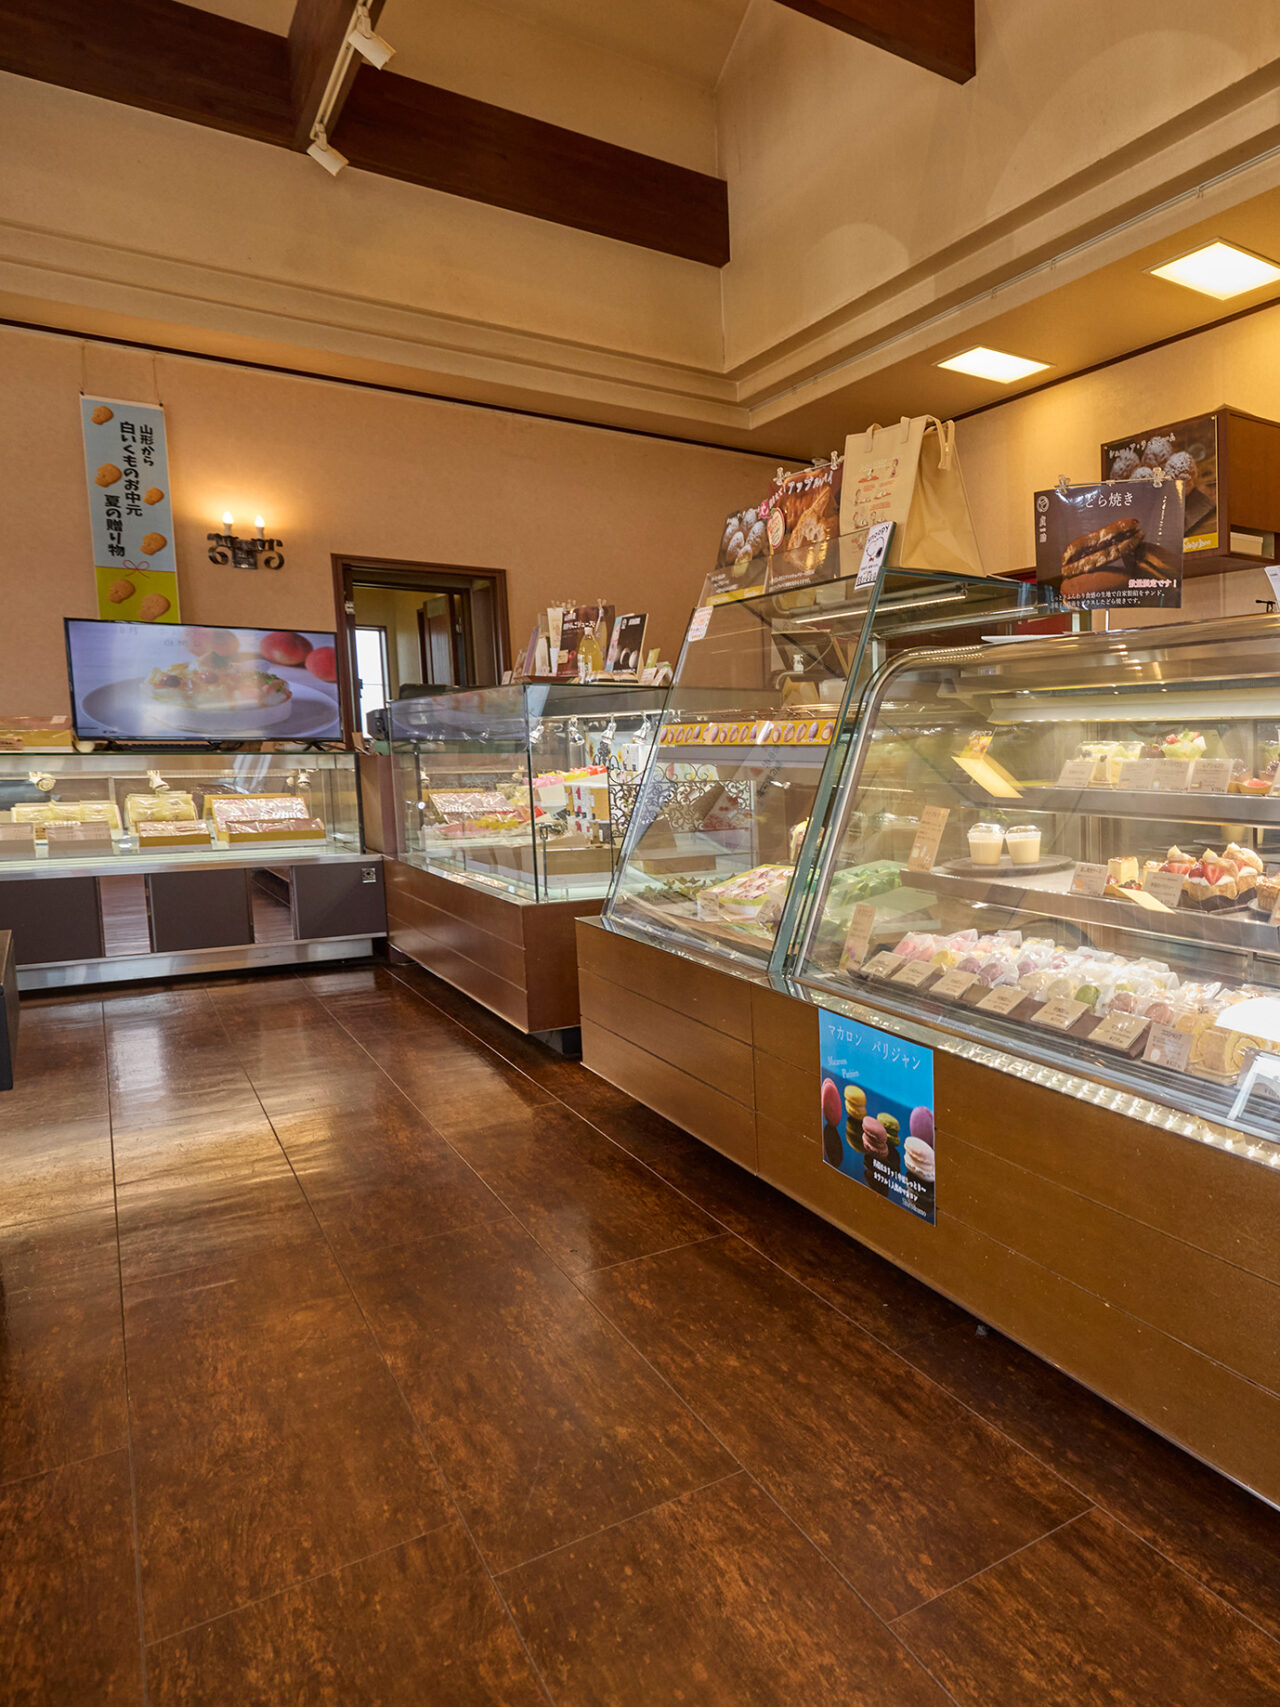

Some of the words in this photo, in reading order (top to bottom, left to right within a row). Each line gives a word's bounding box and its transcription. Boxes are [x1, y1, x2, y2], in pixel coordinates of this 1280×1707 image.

[119, 421, 143, 517] 白いくものお中元
[139, 423, 154, 467] 山形から
[104, 493, 126, 557] 夏の贈り物
[827, 1024, 863, 1046] マカロン
[871, 1040, 921, 1070] パリジャン
